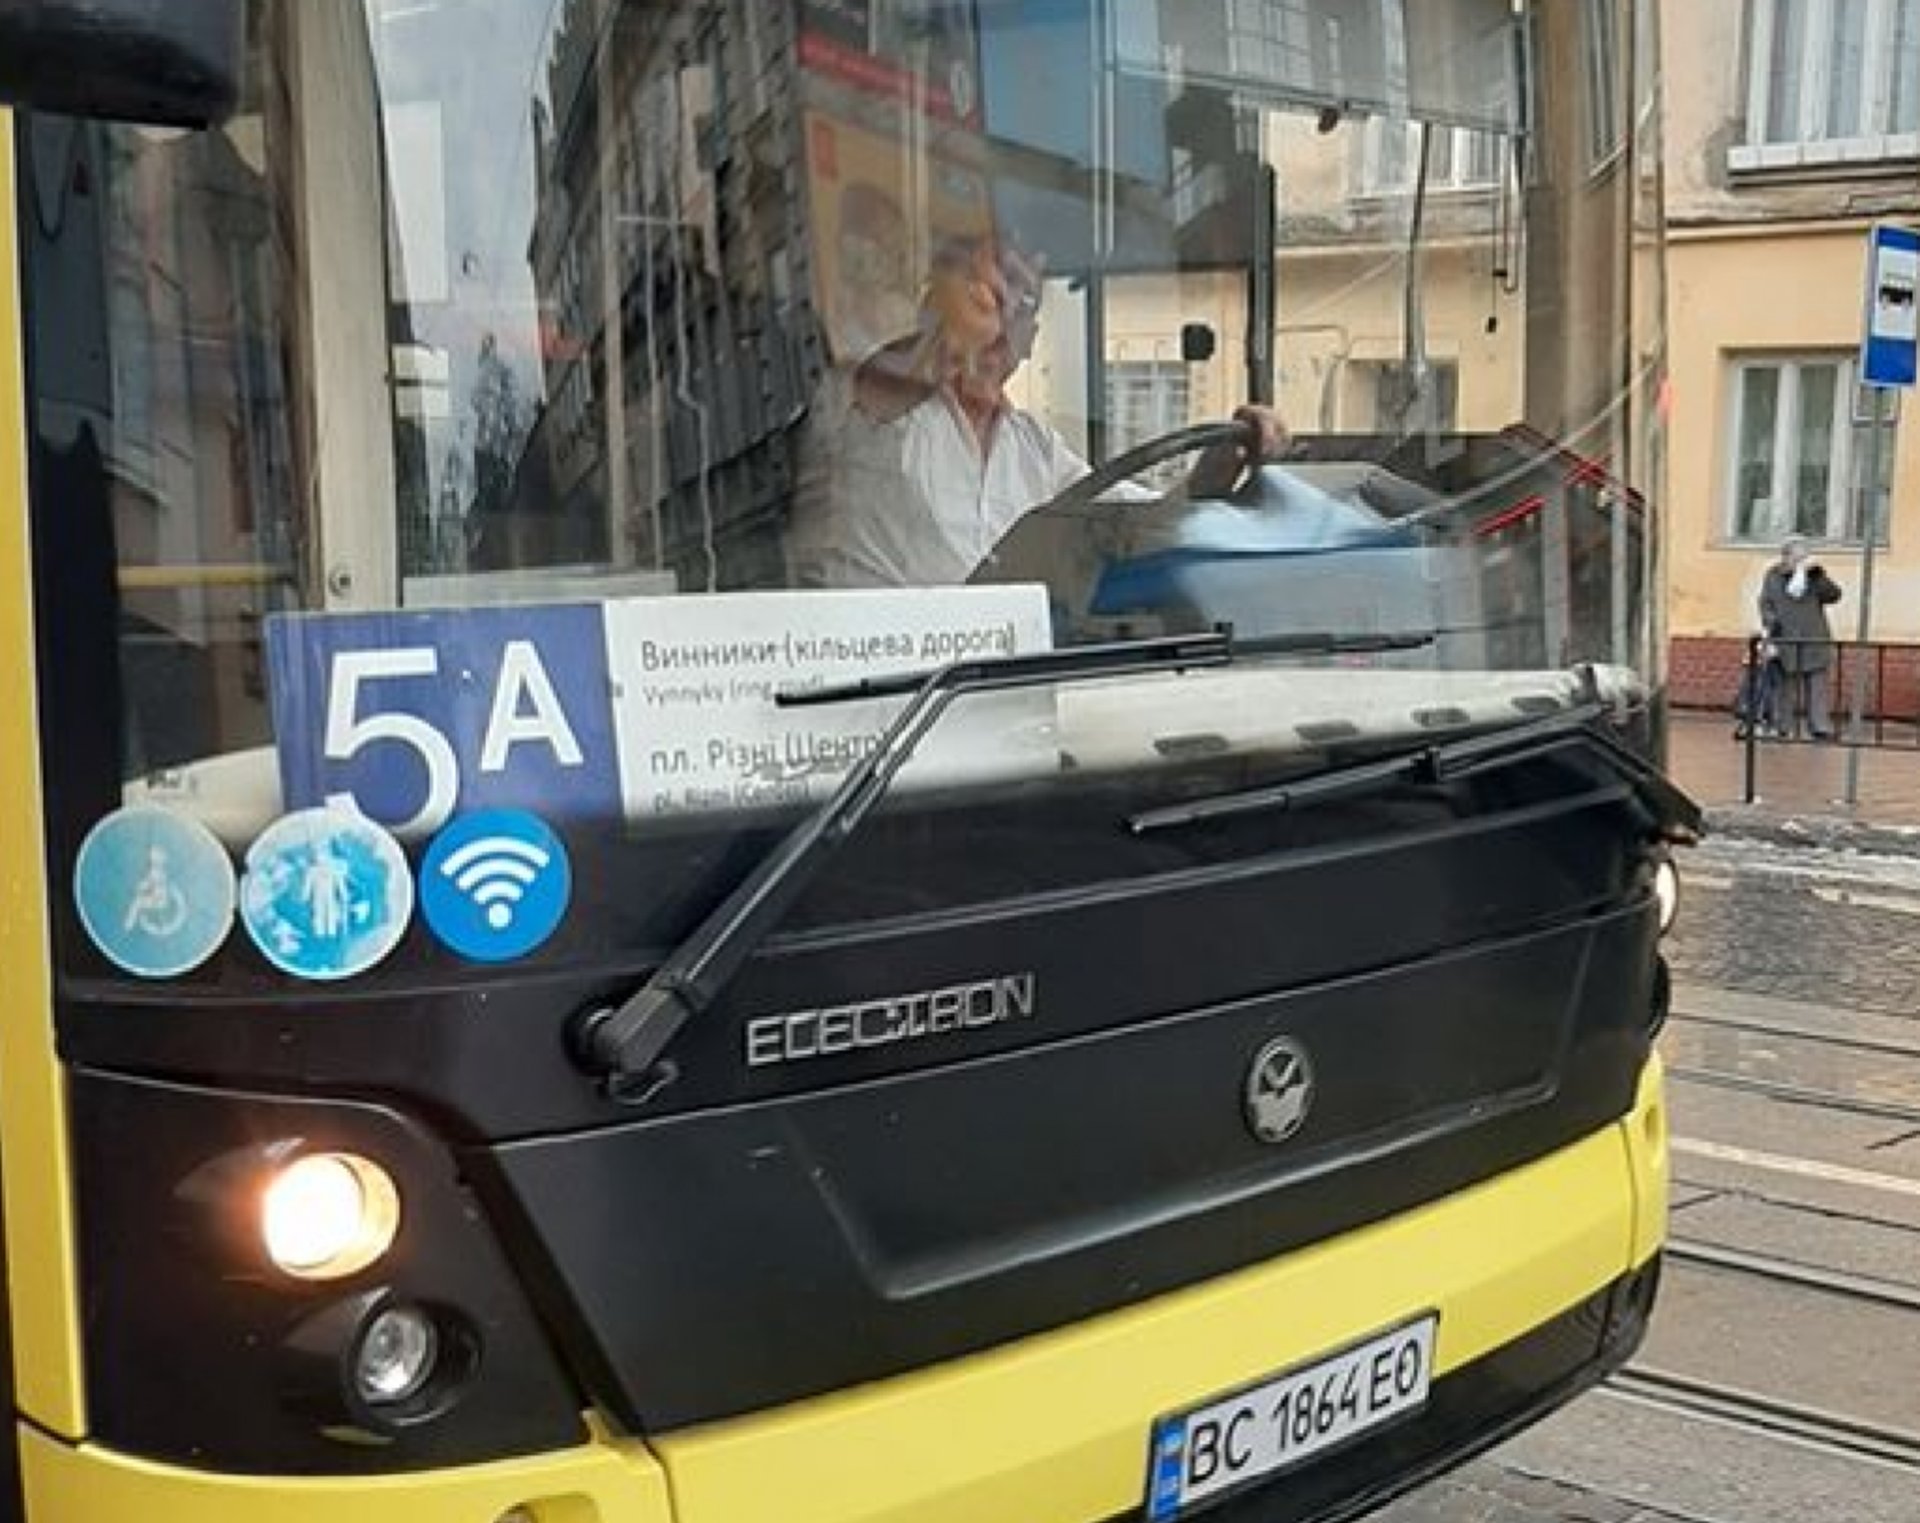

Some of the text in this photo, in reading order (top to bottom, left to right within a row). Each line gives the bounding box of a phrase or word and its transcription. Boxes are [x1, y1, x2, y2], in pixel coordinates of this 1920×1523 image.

[642, 640, 776, 671] Винники
[785, 630, 914, 668] (кільцева
[651, 749, 698, 774] пл.
[785, 731, 885, 768] (Центр
[1187, 1406, 1255, 1485] BC
[1270, 1363, 1361, 1450] 1864
